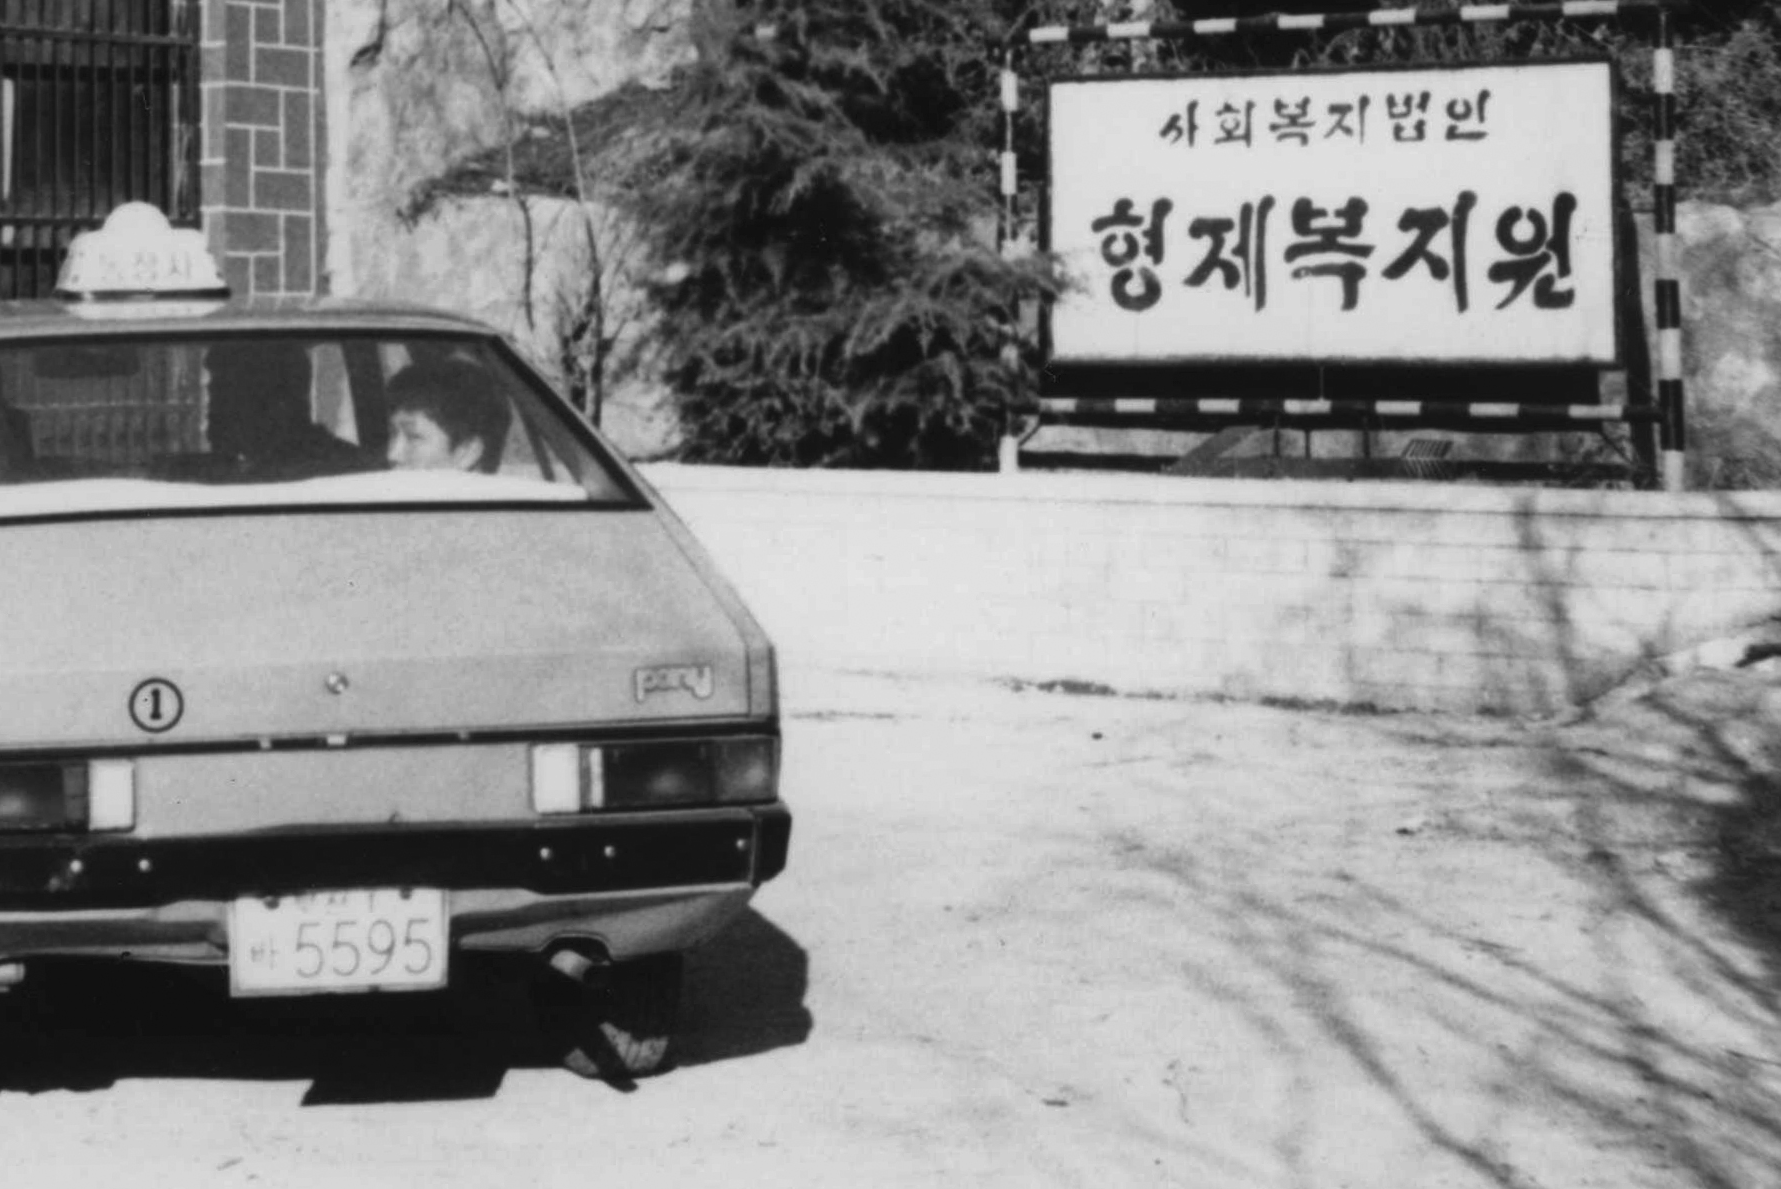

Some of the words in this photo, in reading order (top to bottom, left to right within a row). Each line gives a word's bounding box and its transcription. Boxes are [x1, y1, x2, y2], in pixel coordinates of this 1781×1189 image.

[1159, 89, 1492, 146] 사회복지법인
[1091, 189, 1578, 314] 형제복지원
[294, 917, 434, 979] 5595
